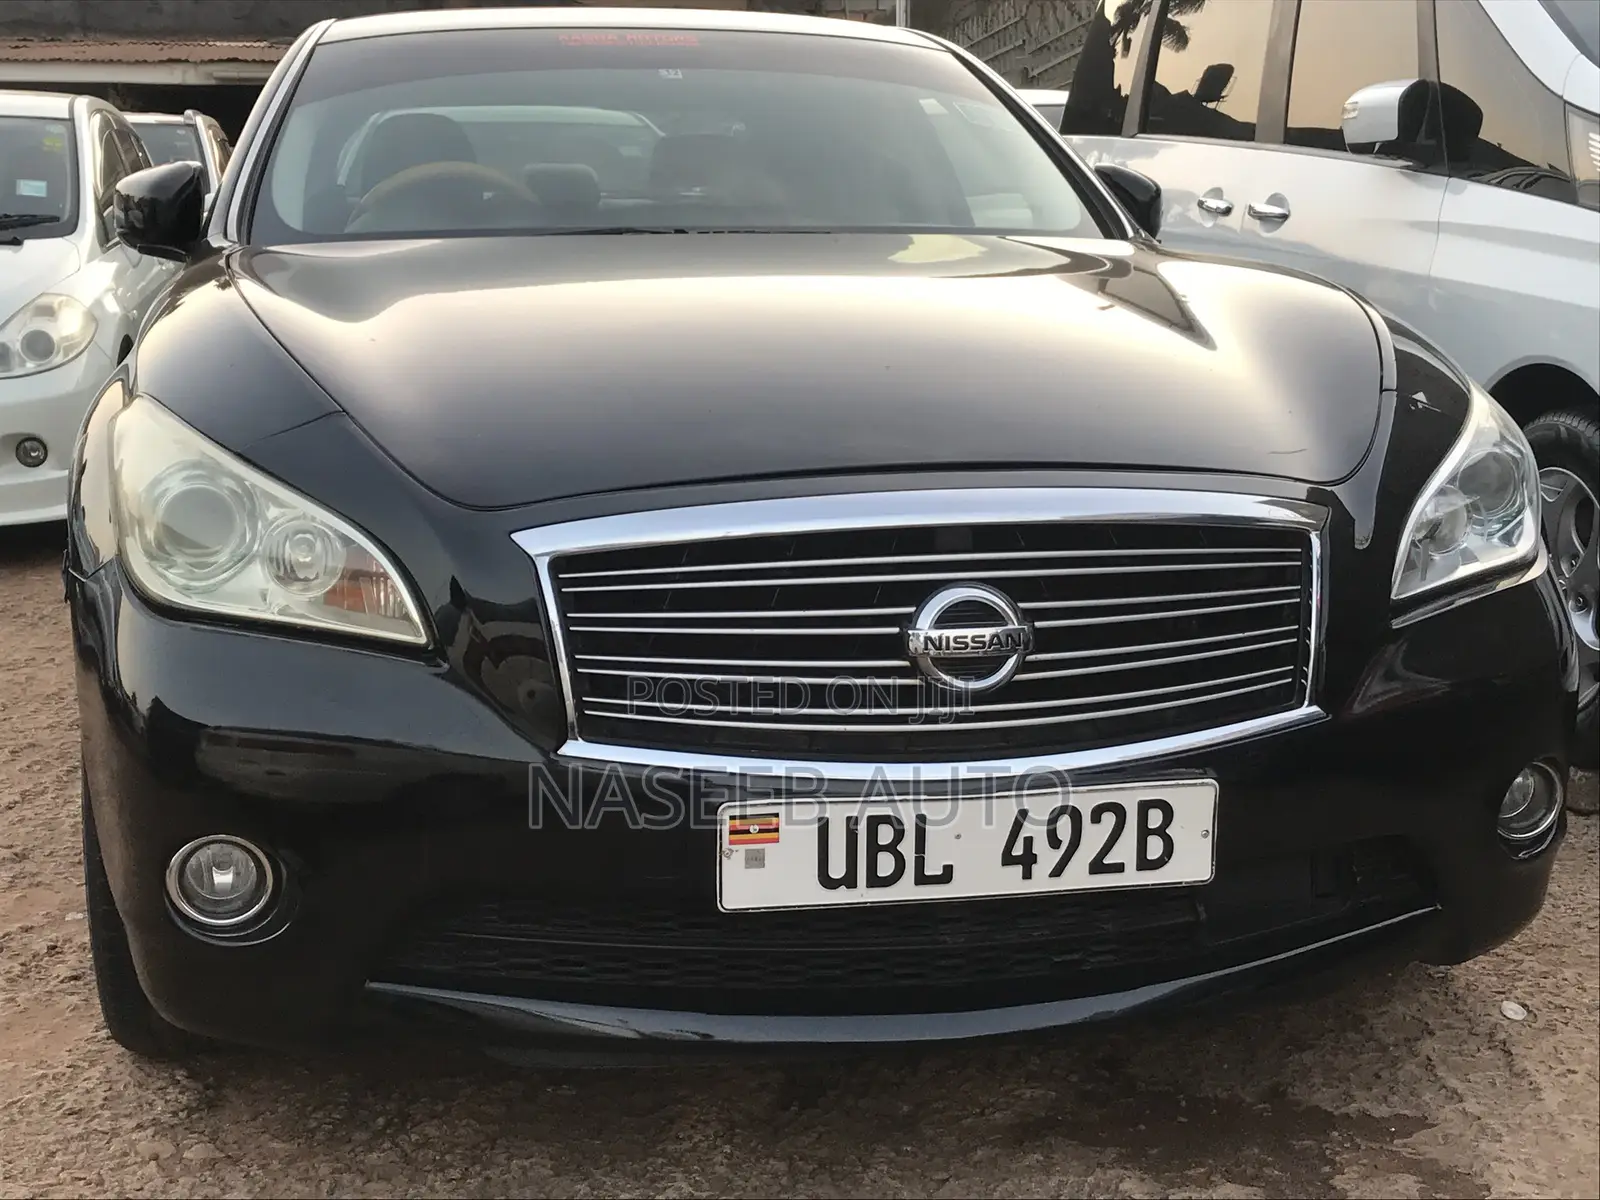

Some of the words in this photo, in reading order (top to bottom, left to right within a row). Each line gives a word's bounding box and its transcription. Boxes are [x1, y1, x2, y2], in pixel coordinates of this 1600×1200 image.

[922, 633, 1022, 652] NISSAN
[817, 813, 954, 891] UBL
[1000, 797, 1175, 881] 492B
